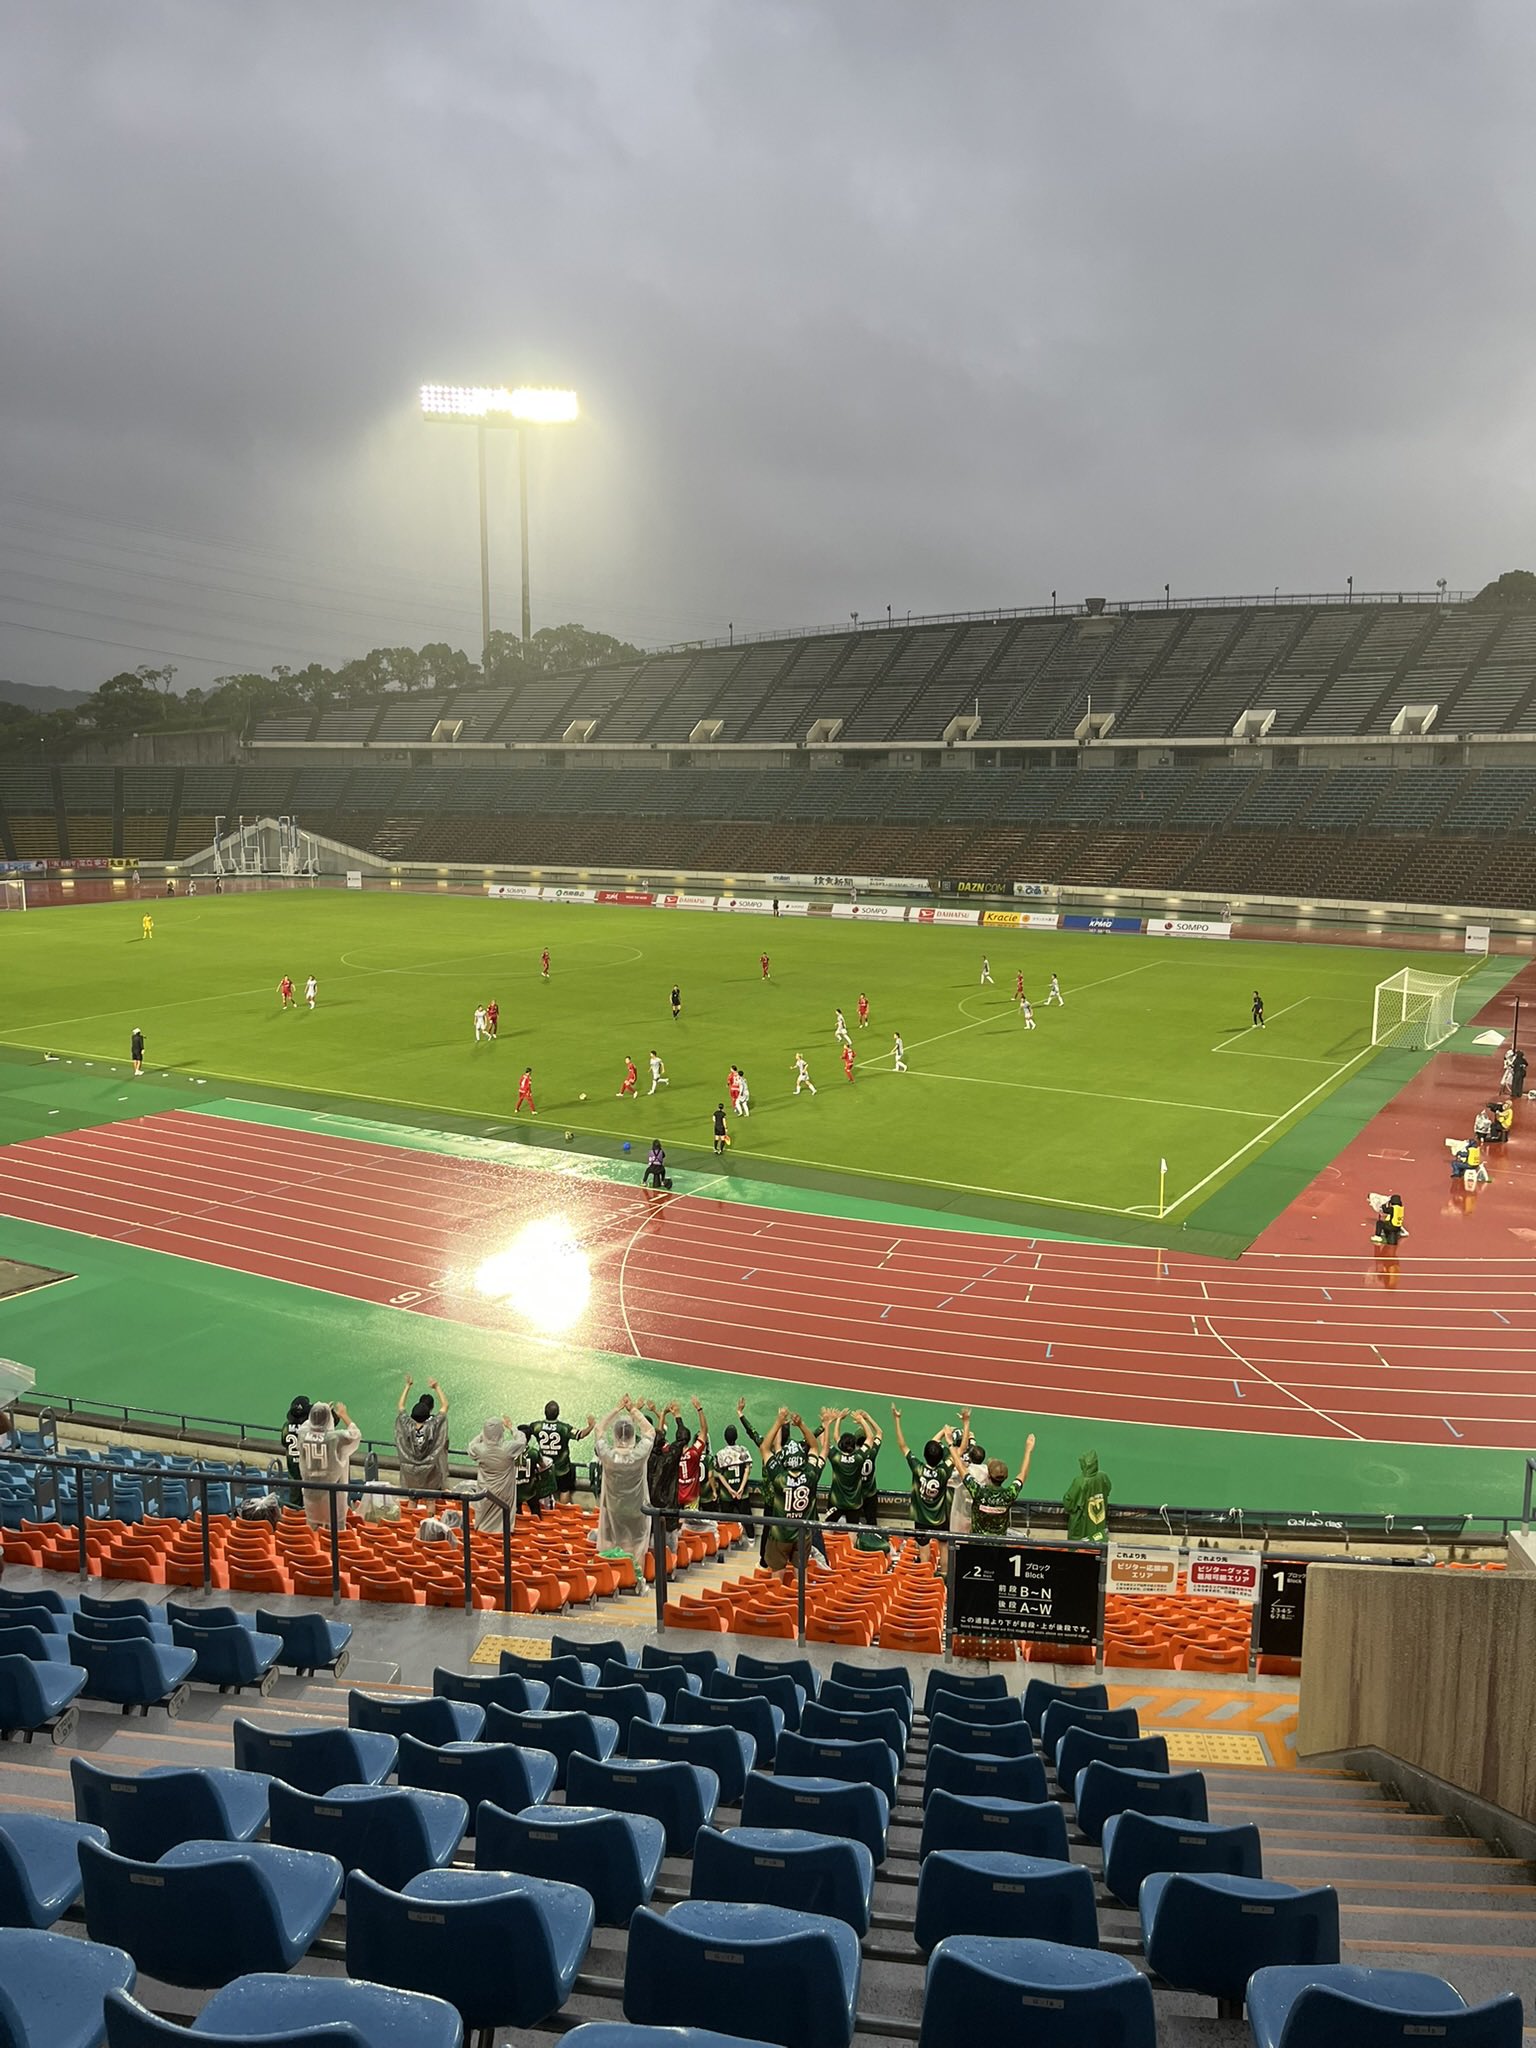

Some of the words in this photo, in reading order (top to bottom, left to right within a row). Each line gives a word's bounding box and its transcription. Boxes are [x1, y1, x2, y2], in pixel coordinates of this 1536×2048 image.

[738, 900, 762, 908] SOMPO
[936, 911, 970, 919] DAIHATSU
[986, 913, 1018, 922] Kracie
[1088, 920, 1113, 928] KPMG
[1176, 923, 1209, 931] SOMPO
[305, 1432, 325, 1442] MJS
[538, 1431, 562, 1450] 22
[302, 1443, 328, 1469] 14
[783, 1485, 810, 1512] 18
[1008, 1554, 1022, 1578] 1
[1025, 1562, 1051, 1572] ブロック
[973, 1565, 982, 1578] 2
[1024, 1571, 1045, 1580] Block
[1131, 1571, 1154, 1579] エリア
[1272, 1571, 1285, 1592] 1
